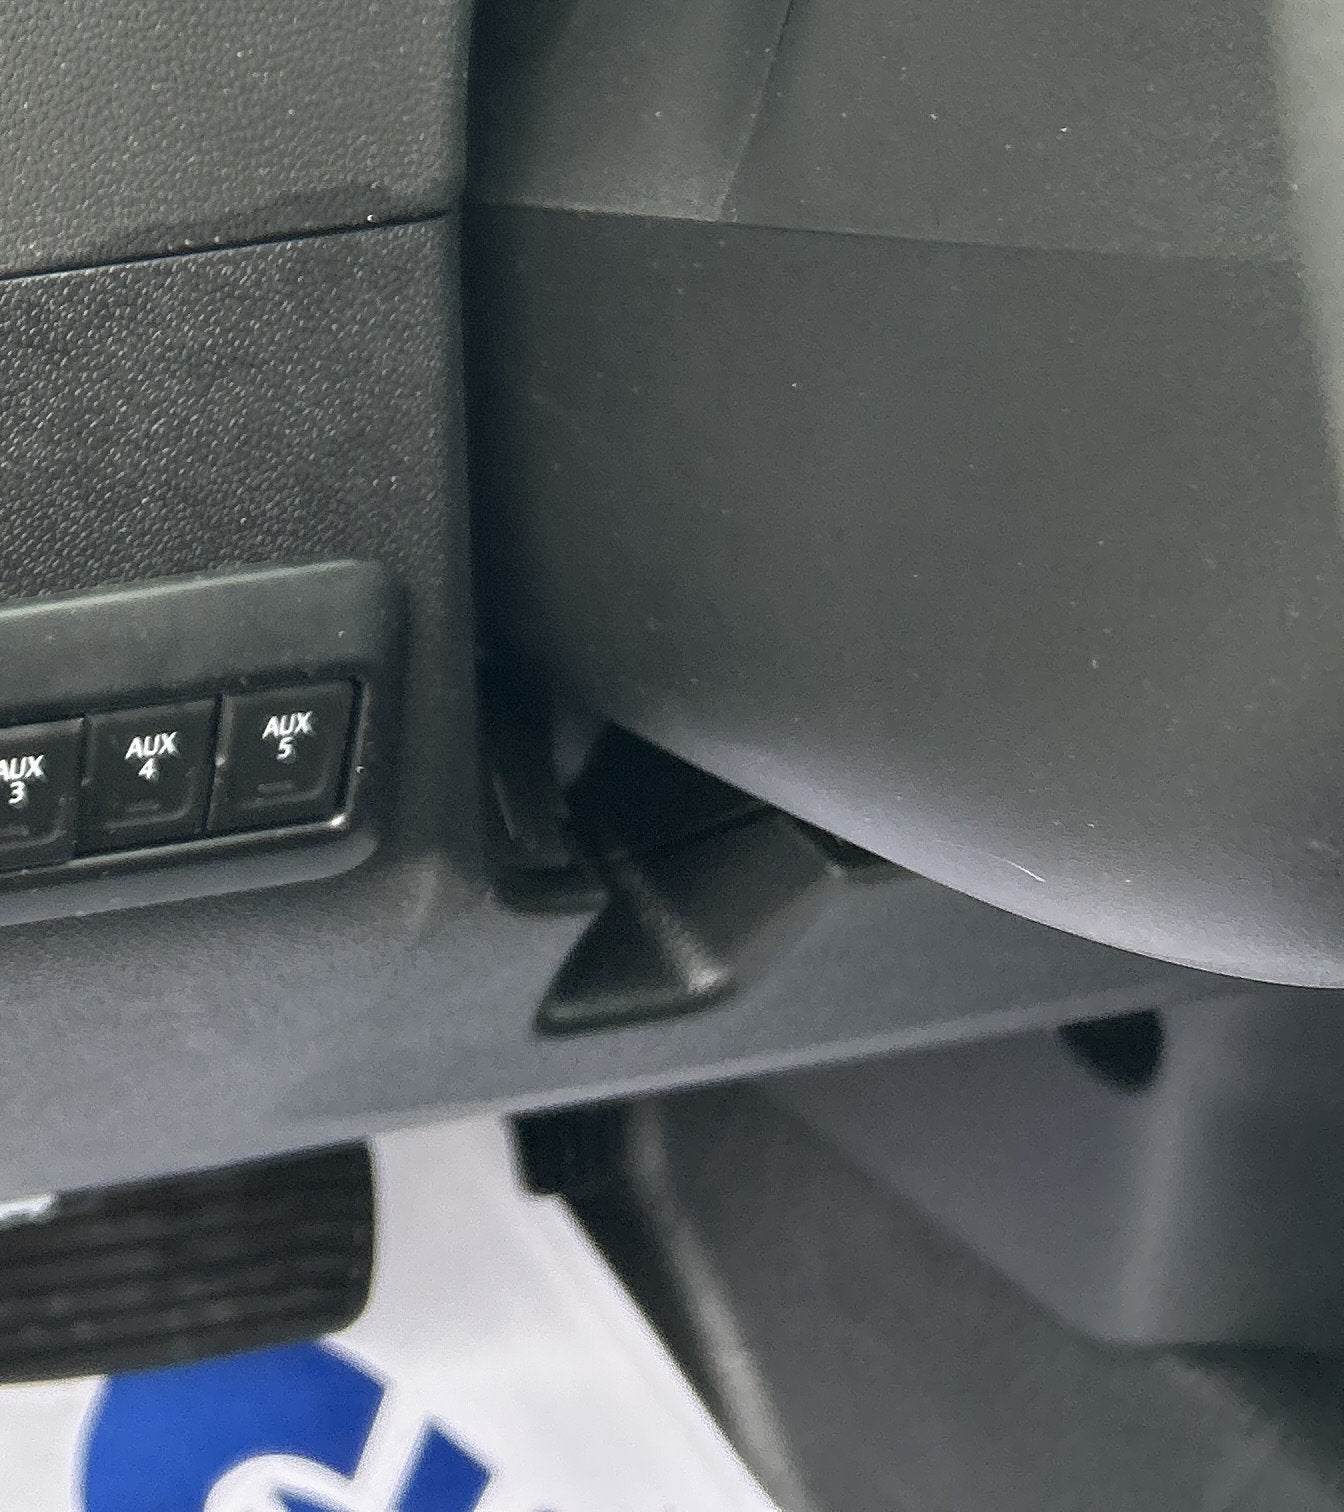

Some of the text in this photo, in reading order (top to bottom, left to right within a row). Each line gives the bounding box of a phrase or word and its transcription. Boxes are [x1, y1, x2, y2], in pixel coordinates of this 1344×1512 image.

[261, 711, 313, 739] AUX
[124, 731, 178, 760] AUX
[276, 738, 295, 759] 5
[138, 758, 157, 780] 4
[7, 781, 27, 805] 3
